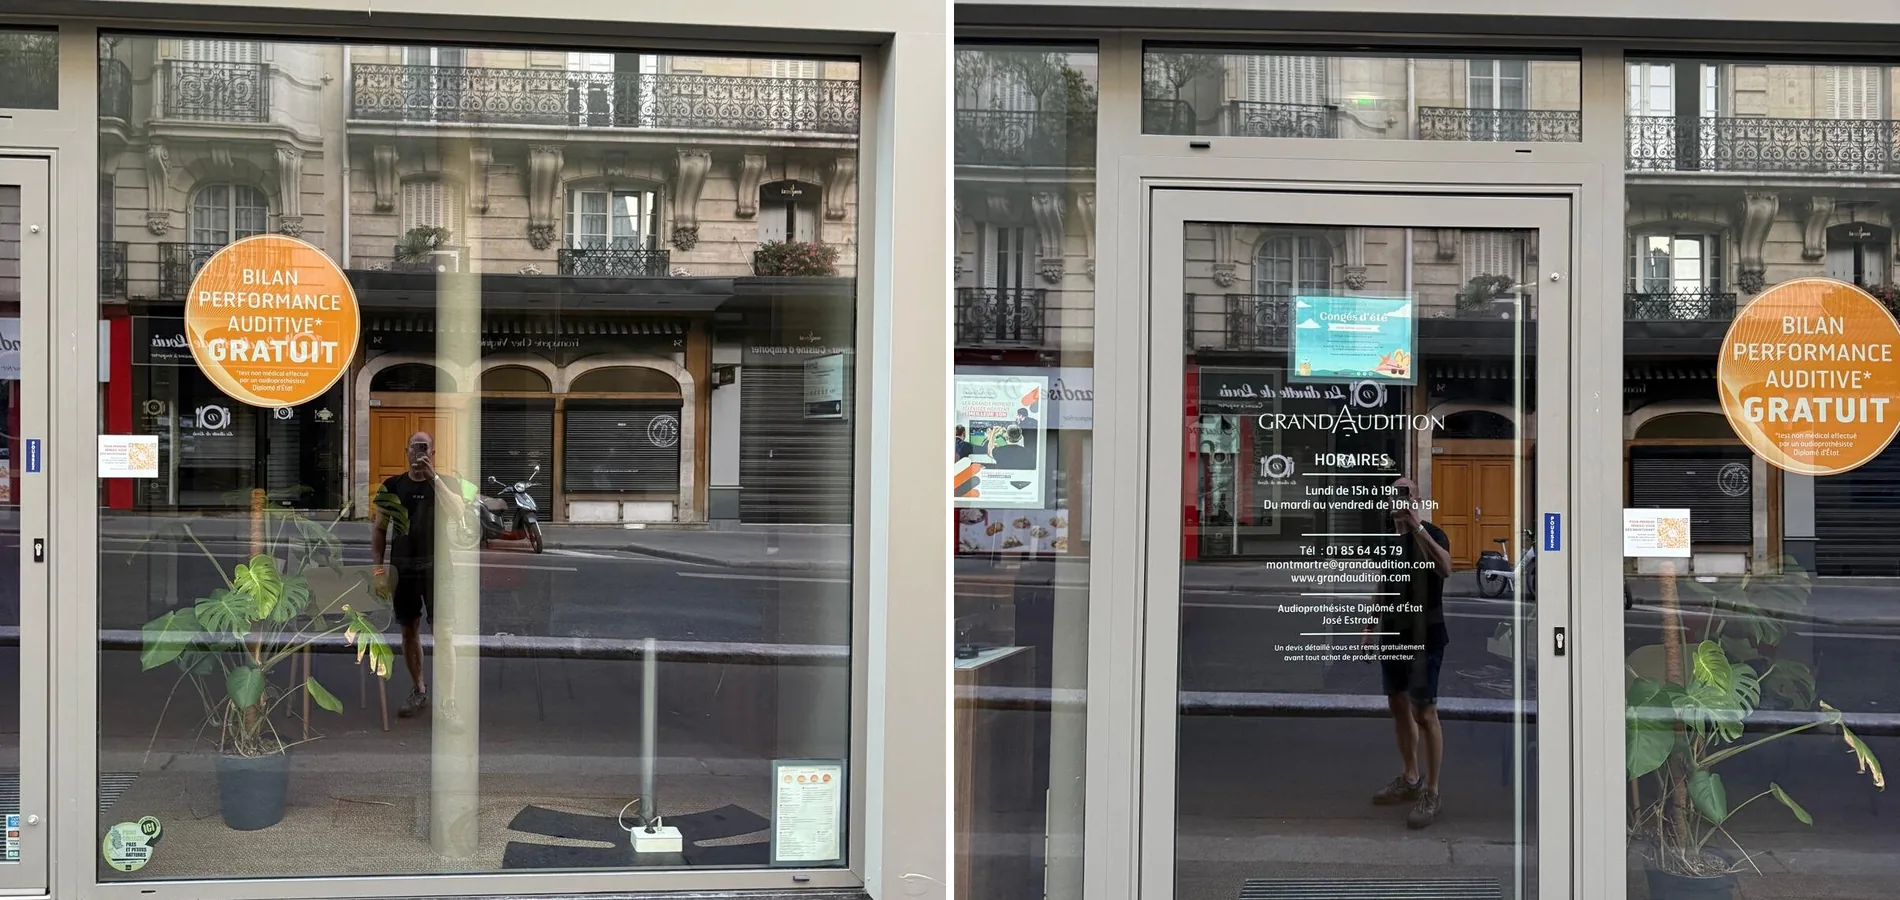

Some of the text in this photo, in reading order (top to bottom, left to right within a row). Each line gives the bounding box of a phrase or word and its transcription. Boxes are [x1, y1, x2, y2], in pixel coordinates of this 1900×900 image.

[242, 268, 299, 286] BILAN
[199, 291, 341, 311] PERFORMANCE
[1320, 312, 1388, 322] Congés d'été
[1782, 316, 1844, 334] BILAN
[207, 338, 338, 363] GRATUIT
[1734, 343, 1892, 362] PERFORMANCE
[1744, 396, 1890, 423] GRATUIT
[1258, 404, 1445, 436] GRANDAUDITION
[1315, 453, 1389, 466] HORAIRES
[1306, 486, 1398, 496] Lundi de 15h à 19h
[1264, 500, 1279, 510] Du
[1281, 500, 1311, 510] mardi
[1328, 500, 1376, 510] vendredi
[1378, 500, 1389, 510] de
[1391, 500, 1409, 510] 10h
[1412, 500, 1418, 510] à
[1421, 500, 1439, 510] 19h
[1300, 545, 1316, 555] Tél
[1326, 546, 1338, 555] 01
[1341, 546, 1354, 555] 85
[1357, 546, 1370, 555] 64
[1374, 546, 1387, 555] 45
[1390, 546, 1403, 555] 79
[1266, 560, 1435, 571] montmartre@grandaudition.com
[1291, 574, 1410, 584] www.grandaudition.com
[1278, 602, 1422, 615] Audioprothésiste Diplômé d'État
[1322, 616, 1379, 625] José Estrada
[1352, 654, 1377, 662] produit
[142, 822, 156, 834] ICI
